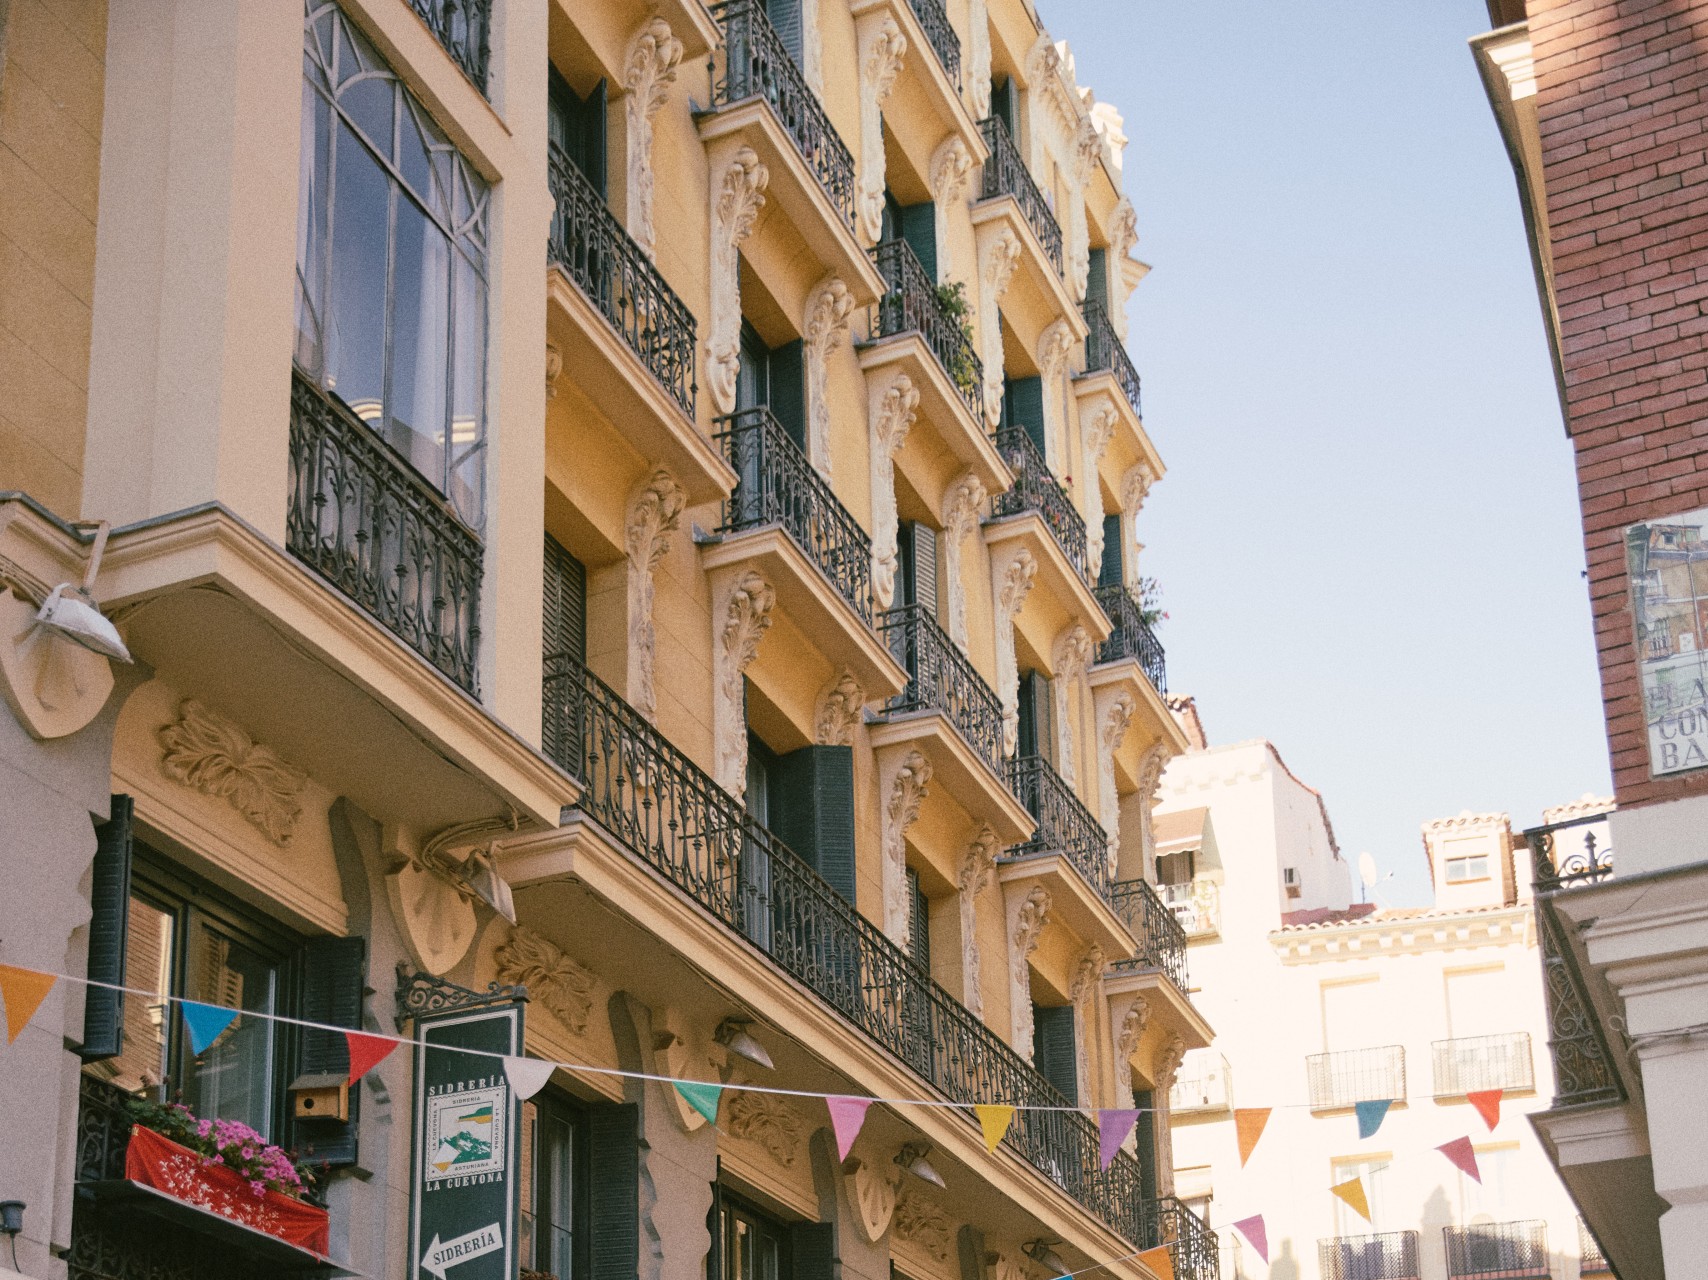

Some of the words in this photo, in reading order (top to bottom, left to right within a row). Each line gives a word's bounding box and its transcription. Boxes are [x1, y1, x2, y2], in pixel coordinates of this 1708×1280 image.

[429, 1075, 506, 1096] SIDRERÍA
[452, 1096, 481, 1105] SIDRERIA
[454, 1162, 489, 1171] ASTURIANA
[426, 1179, 441, 1192] LA
[446, 1170, 504, 1189] CUEVONA
[432, 1229, 496, 1266] SIDRERÍA
